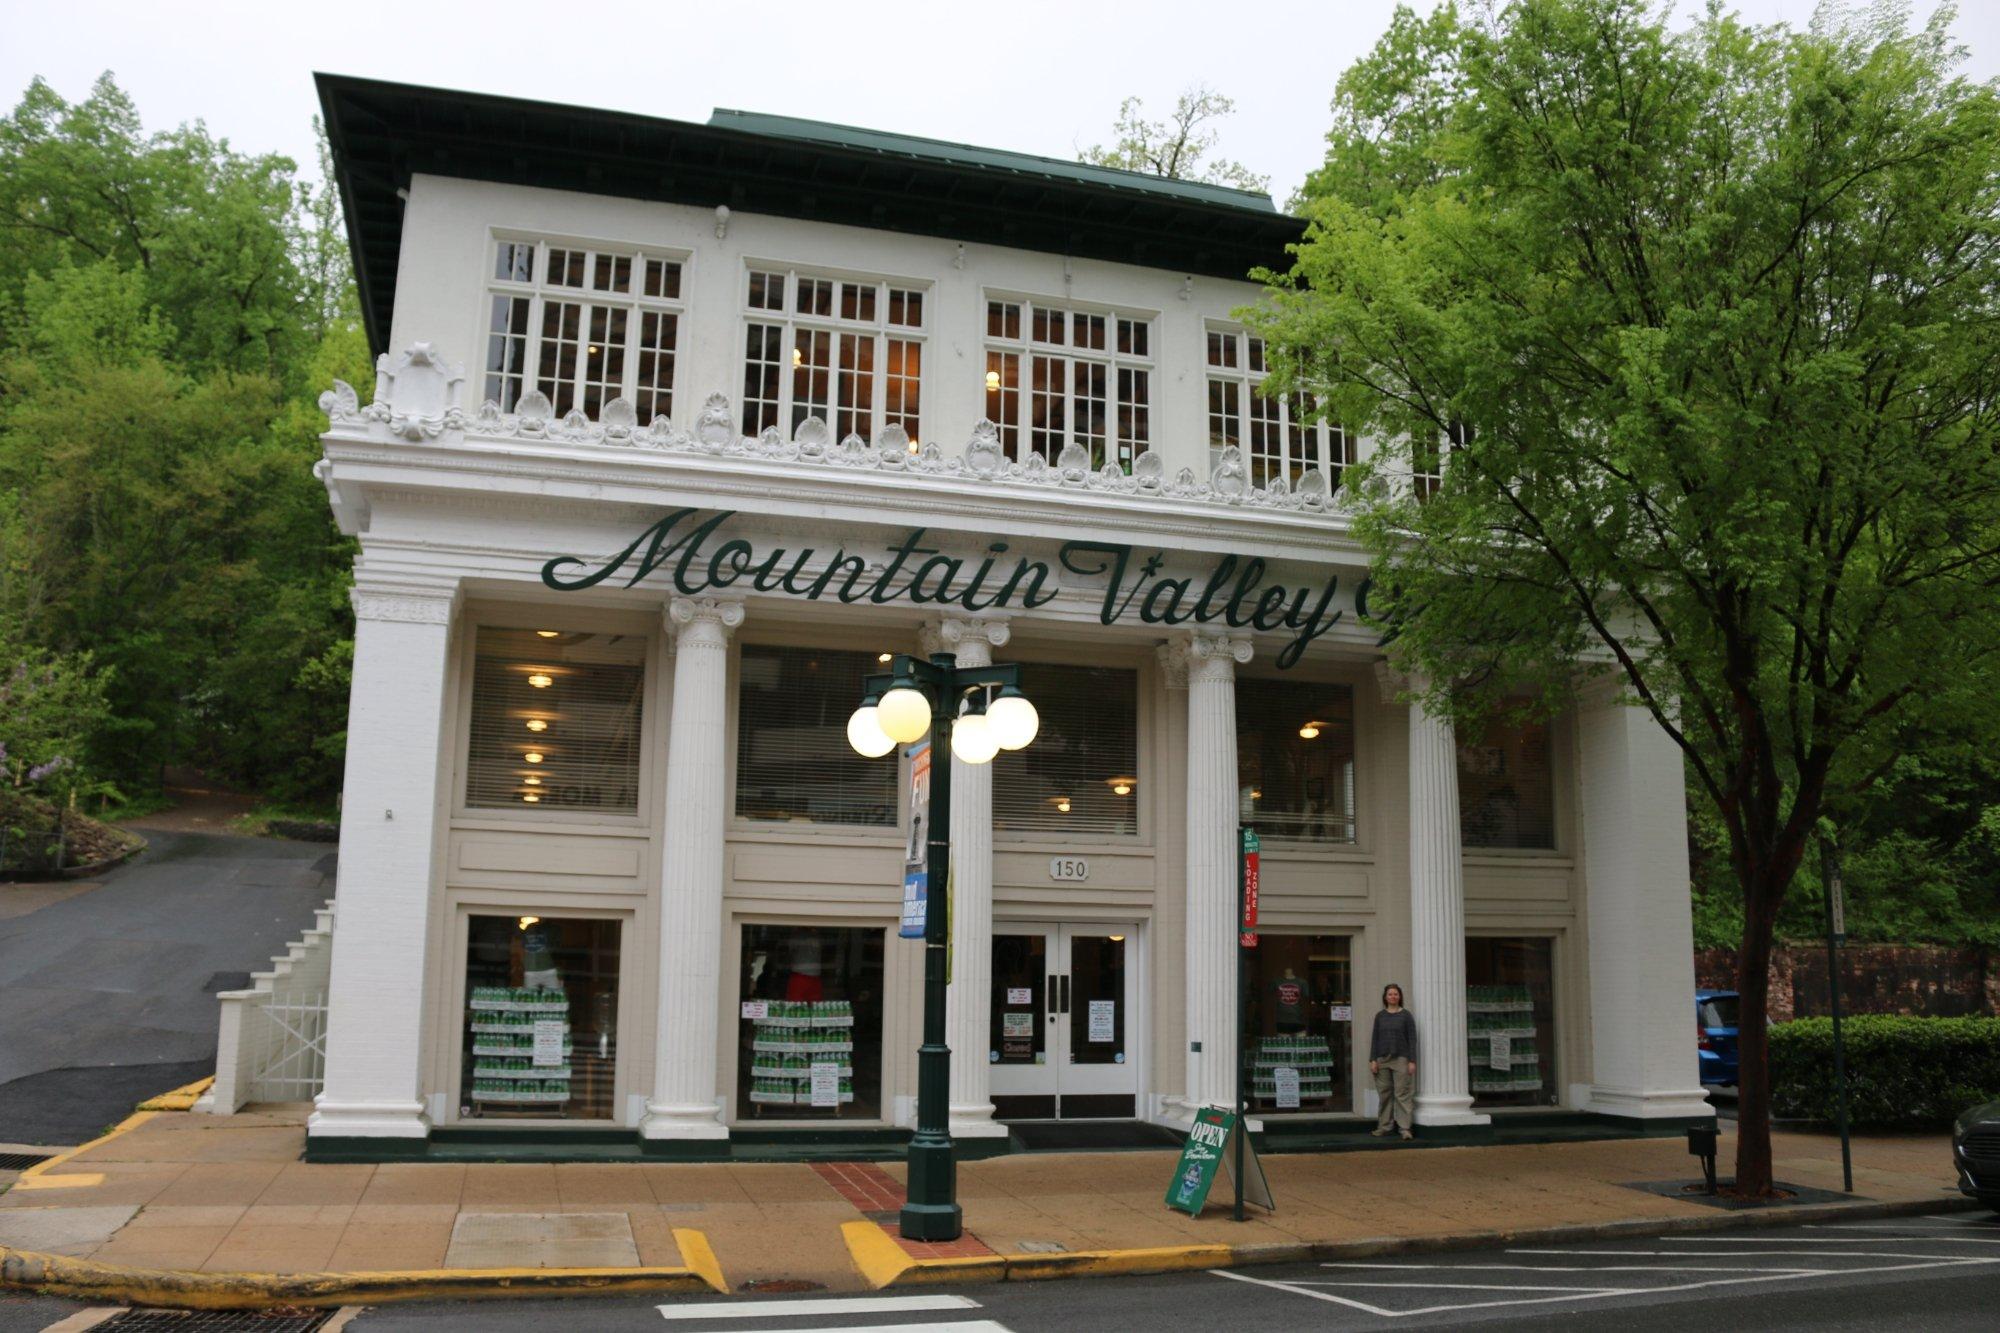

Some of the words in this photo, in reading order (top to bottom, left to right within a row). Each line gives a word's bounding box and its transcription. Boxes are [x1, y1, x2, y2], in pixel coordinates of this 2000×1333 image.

[541, 507, 1059, 611] Mountain
[1059, 541, 1342, 670] Valley
[1055, 860, 1086, 877] 150
[1191, 1121, 1229, 1148] OPEN
